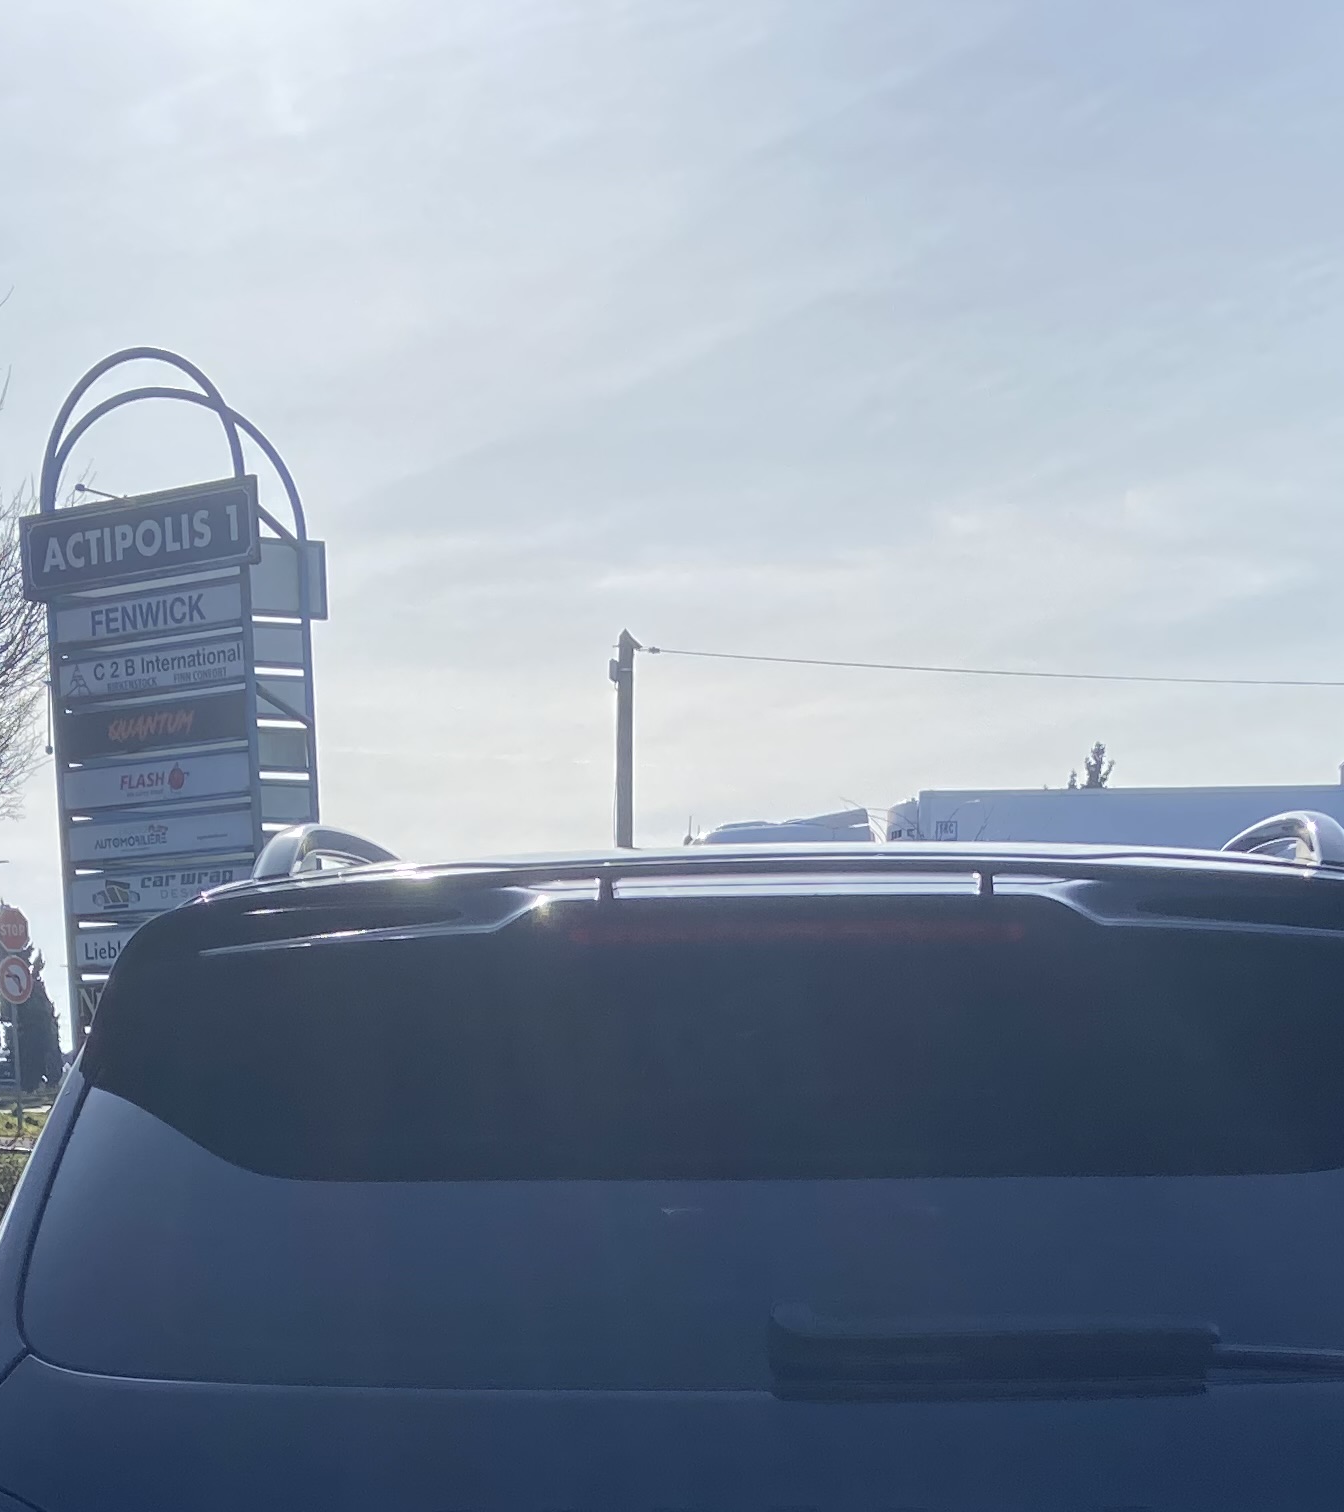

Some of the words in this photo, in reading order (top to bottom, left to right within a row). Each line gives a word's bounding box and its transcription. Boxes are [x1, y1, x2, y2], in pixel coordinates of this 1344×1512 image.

[43, 509, 212, 573] ACTIPOLIS
[225, 504, 239, 542] 1
[90, 592, 207, 637] FENWICK
[93, 663, 106, 681] C
[110, 659, 121, 678] 2
[124, 657, 136, 677] B
[141, 643, 242, 675] International
[120, 771, 165, 790] FLASH
[141, 874, 176, 888] car
[0, 923, 25, 937] STOP
